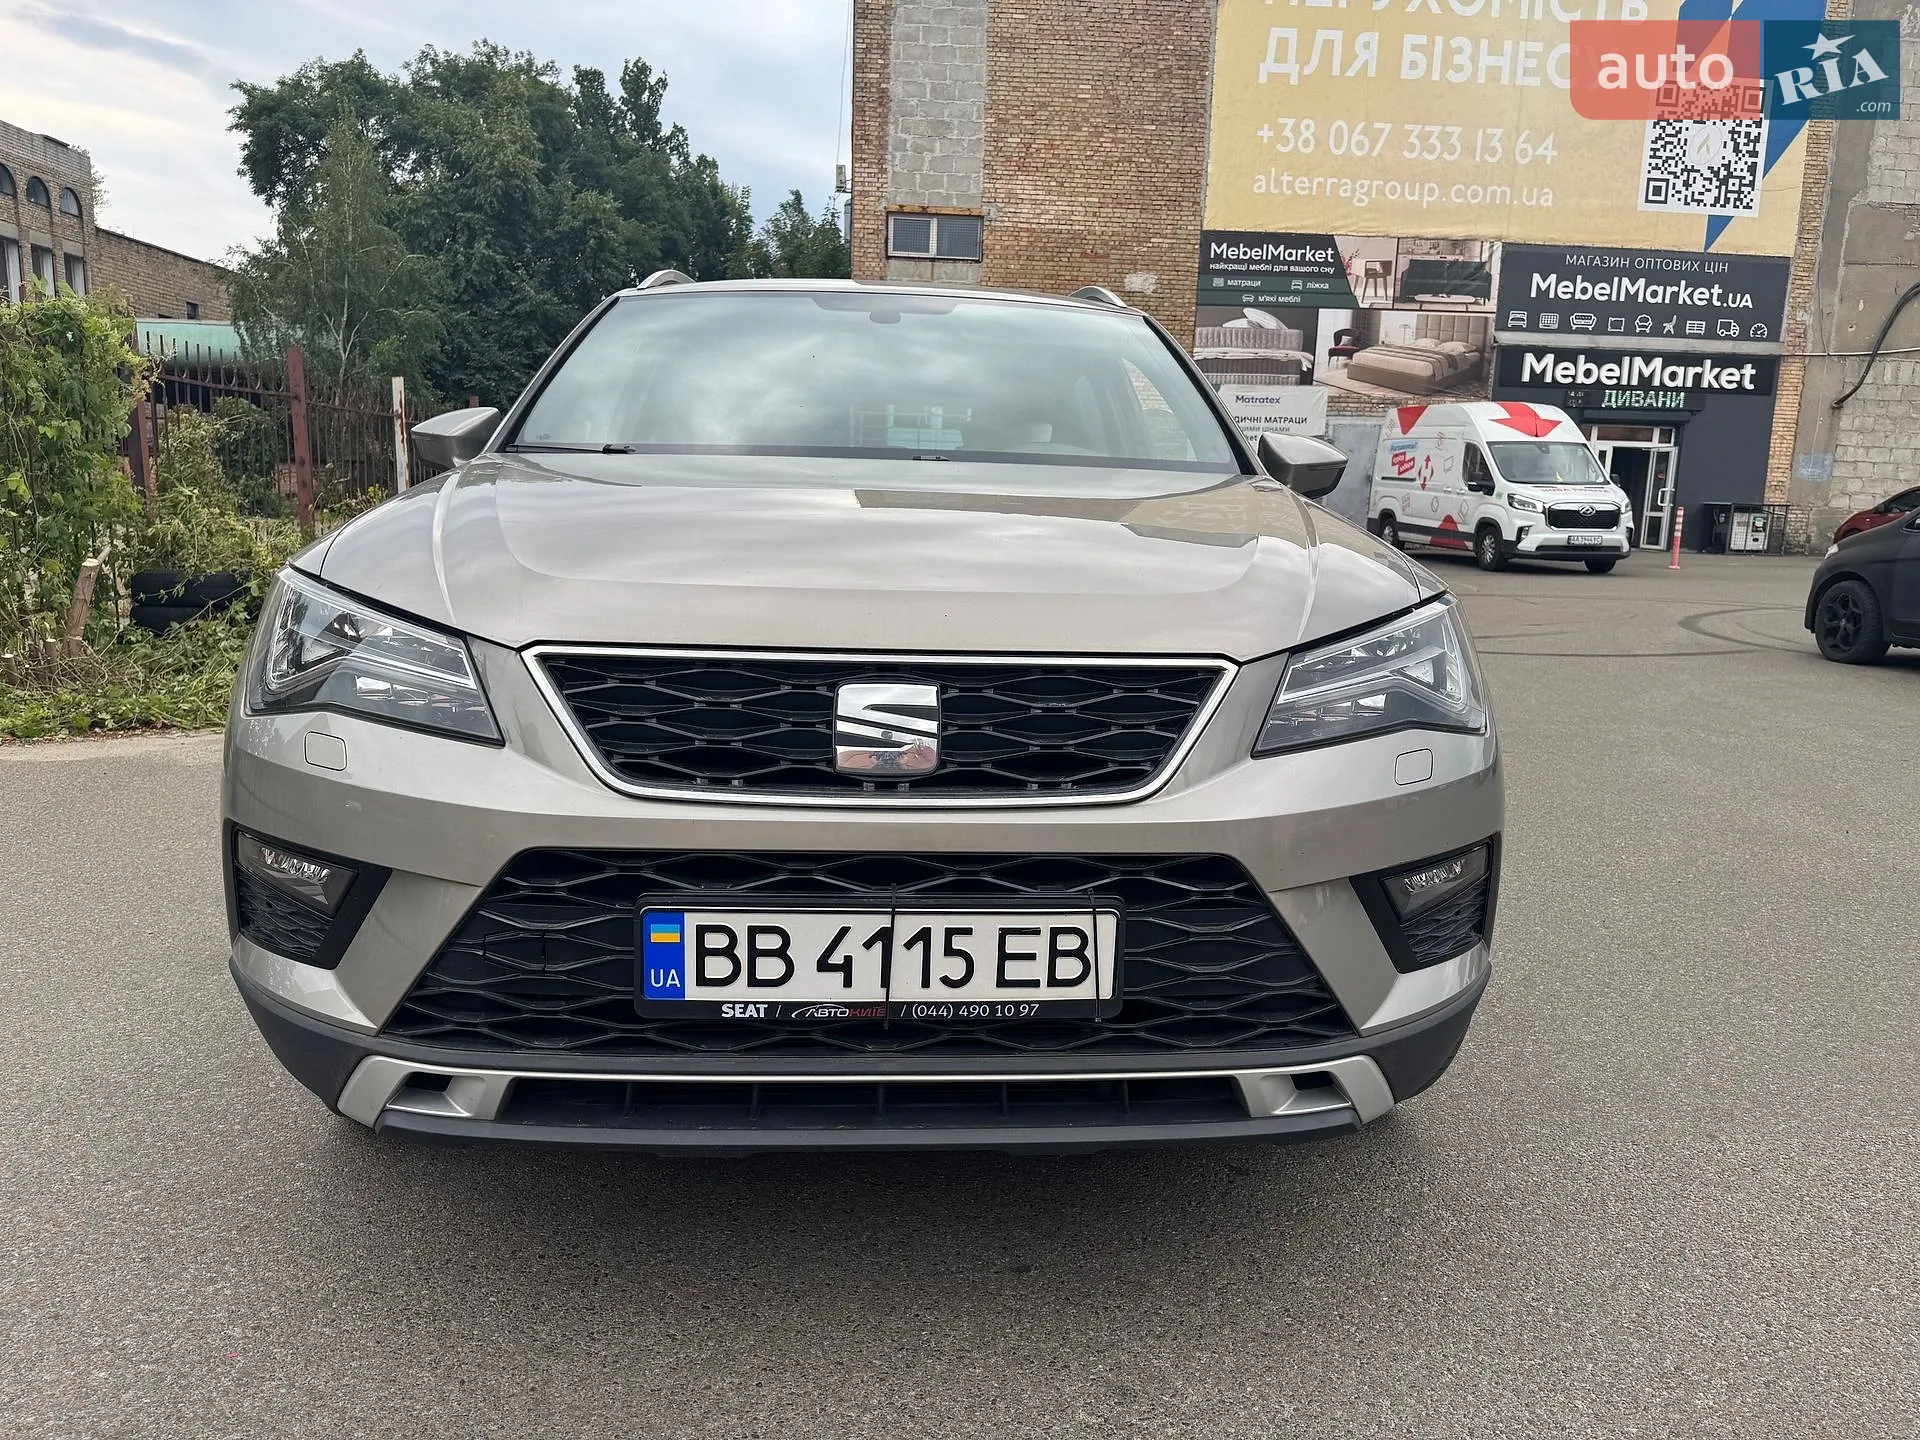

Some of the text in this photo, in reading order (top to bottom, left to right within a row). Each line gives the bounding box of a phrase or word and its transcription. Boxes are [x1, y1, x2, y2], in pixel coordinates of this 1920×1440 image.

[1259, 27, 1380, 85] ДЛЯ
[1256, 117, 1558, 165] +38 067 333 13 64
[1252, 167, 1554, 208] alterragroup.com.ua
[1209, 241, 1335, 263] MebelMarket
[1209, 262, 1335, 275] найкращі меблі для вашого сну
[1565, 253, 1729, 274] МАГАЗИН ОПТОВИХ ЦІН
[1227, 279, 1262, 288] матраци
[1530, 271, 1754, 310] MebelMarket.UA
[1520, 351, 1757, 391] MebelMarket
[1235, 395, 1281, 405] Matratex
[1601, 389, 1685, 409] ДИВАНИ
[1263, 416, 1308, 425] МАТРАЦИ
[695, 923, 1092, 990] BB 4115 EB
[650, 968, 681, 988] UA
[721, 1003, 768, 1018] SEAT
[911, 1003, 954, 1019] (044)
[959, 1004, 989, 1018] 490
[994, 1004, 1014, 1017] 10
[1018, 1004, 1039, 1018] 97
